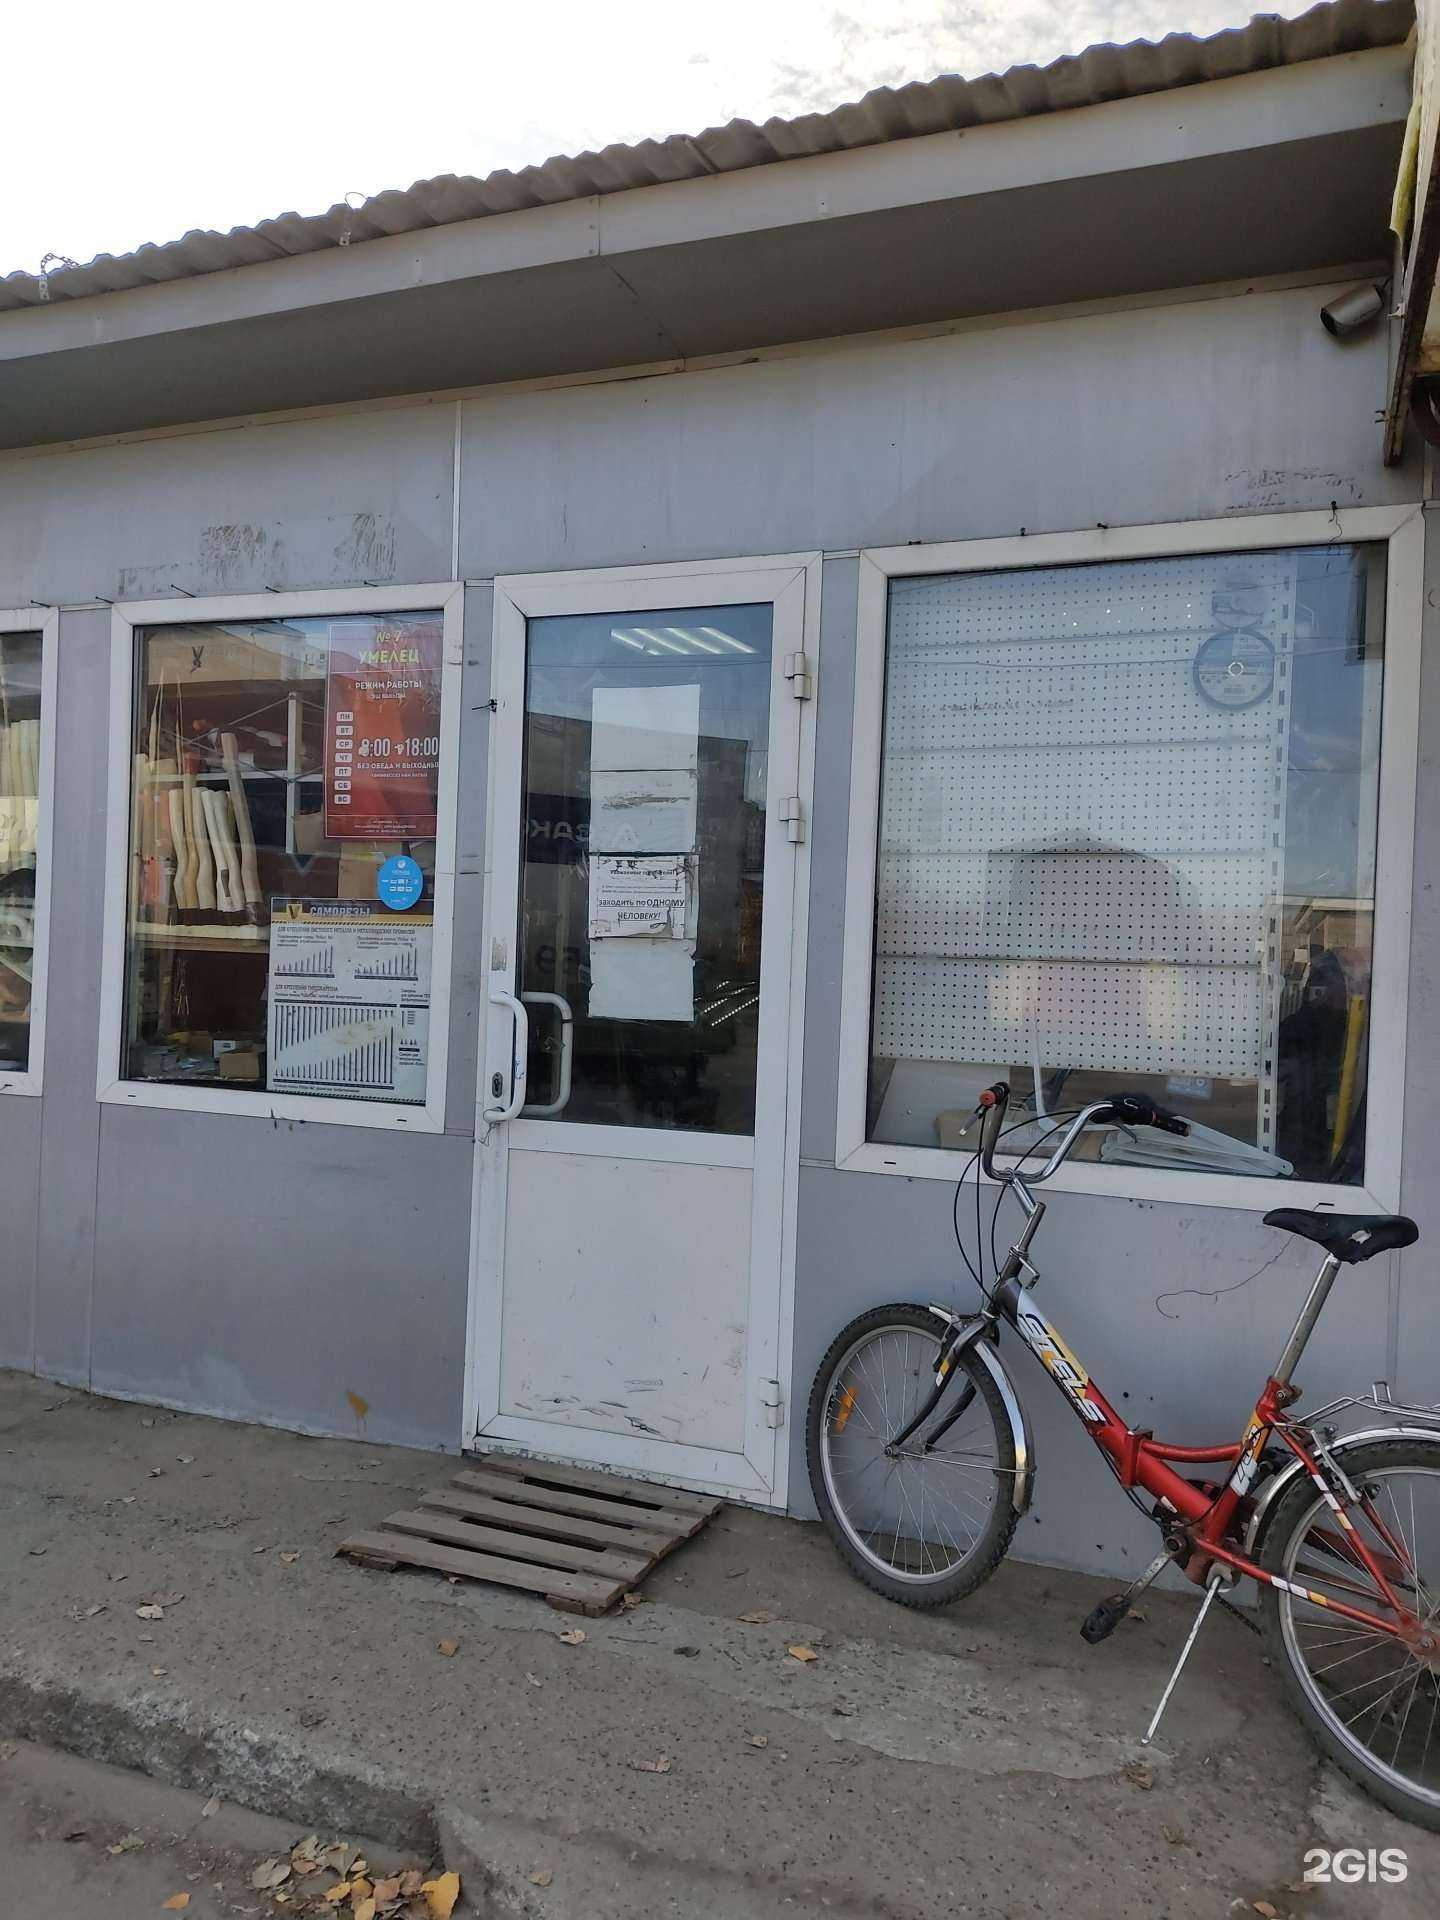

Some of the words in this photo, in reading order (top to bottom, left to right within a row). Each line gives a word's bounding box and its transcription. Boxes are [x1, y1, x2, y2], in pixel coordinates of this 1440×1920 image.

[359, 647, 420, 664] УМЕЛЕЦ
[355, 681, 385, 689] РЕЖИМ
[405, 736, 439, 756] 18:00
[647, 898, 685, 908] ОДНОМУ
[310, 905, 370, 918] САМОРЕЗЫ
[1017, 1312, 1115, 1428] STELS
